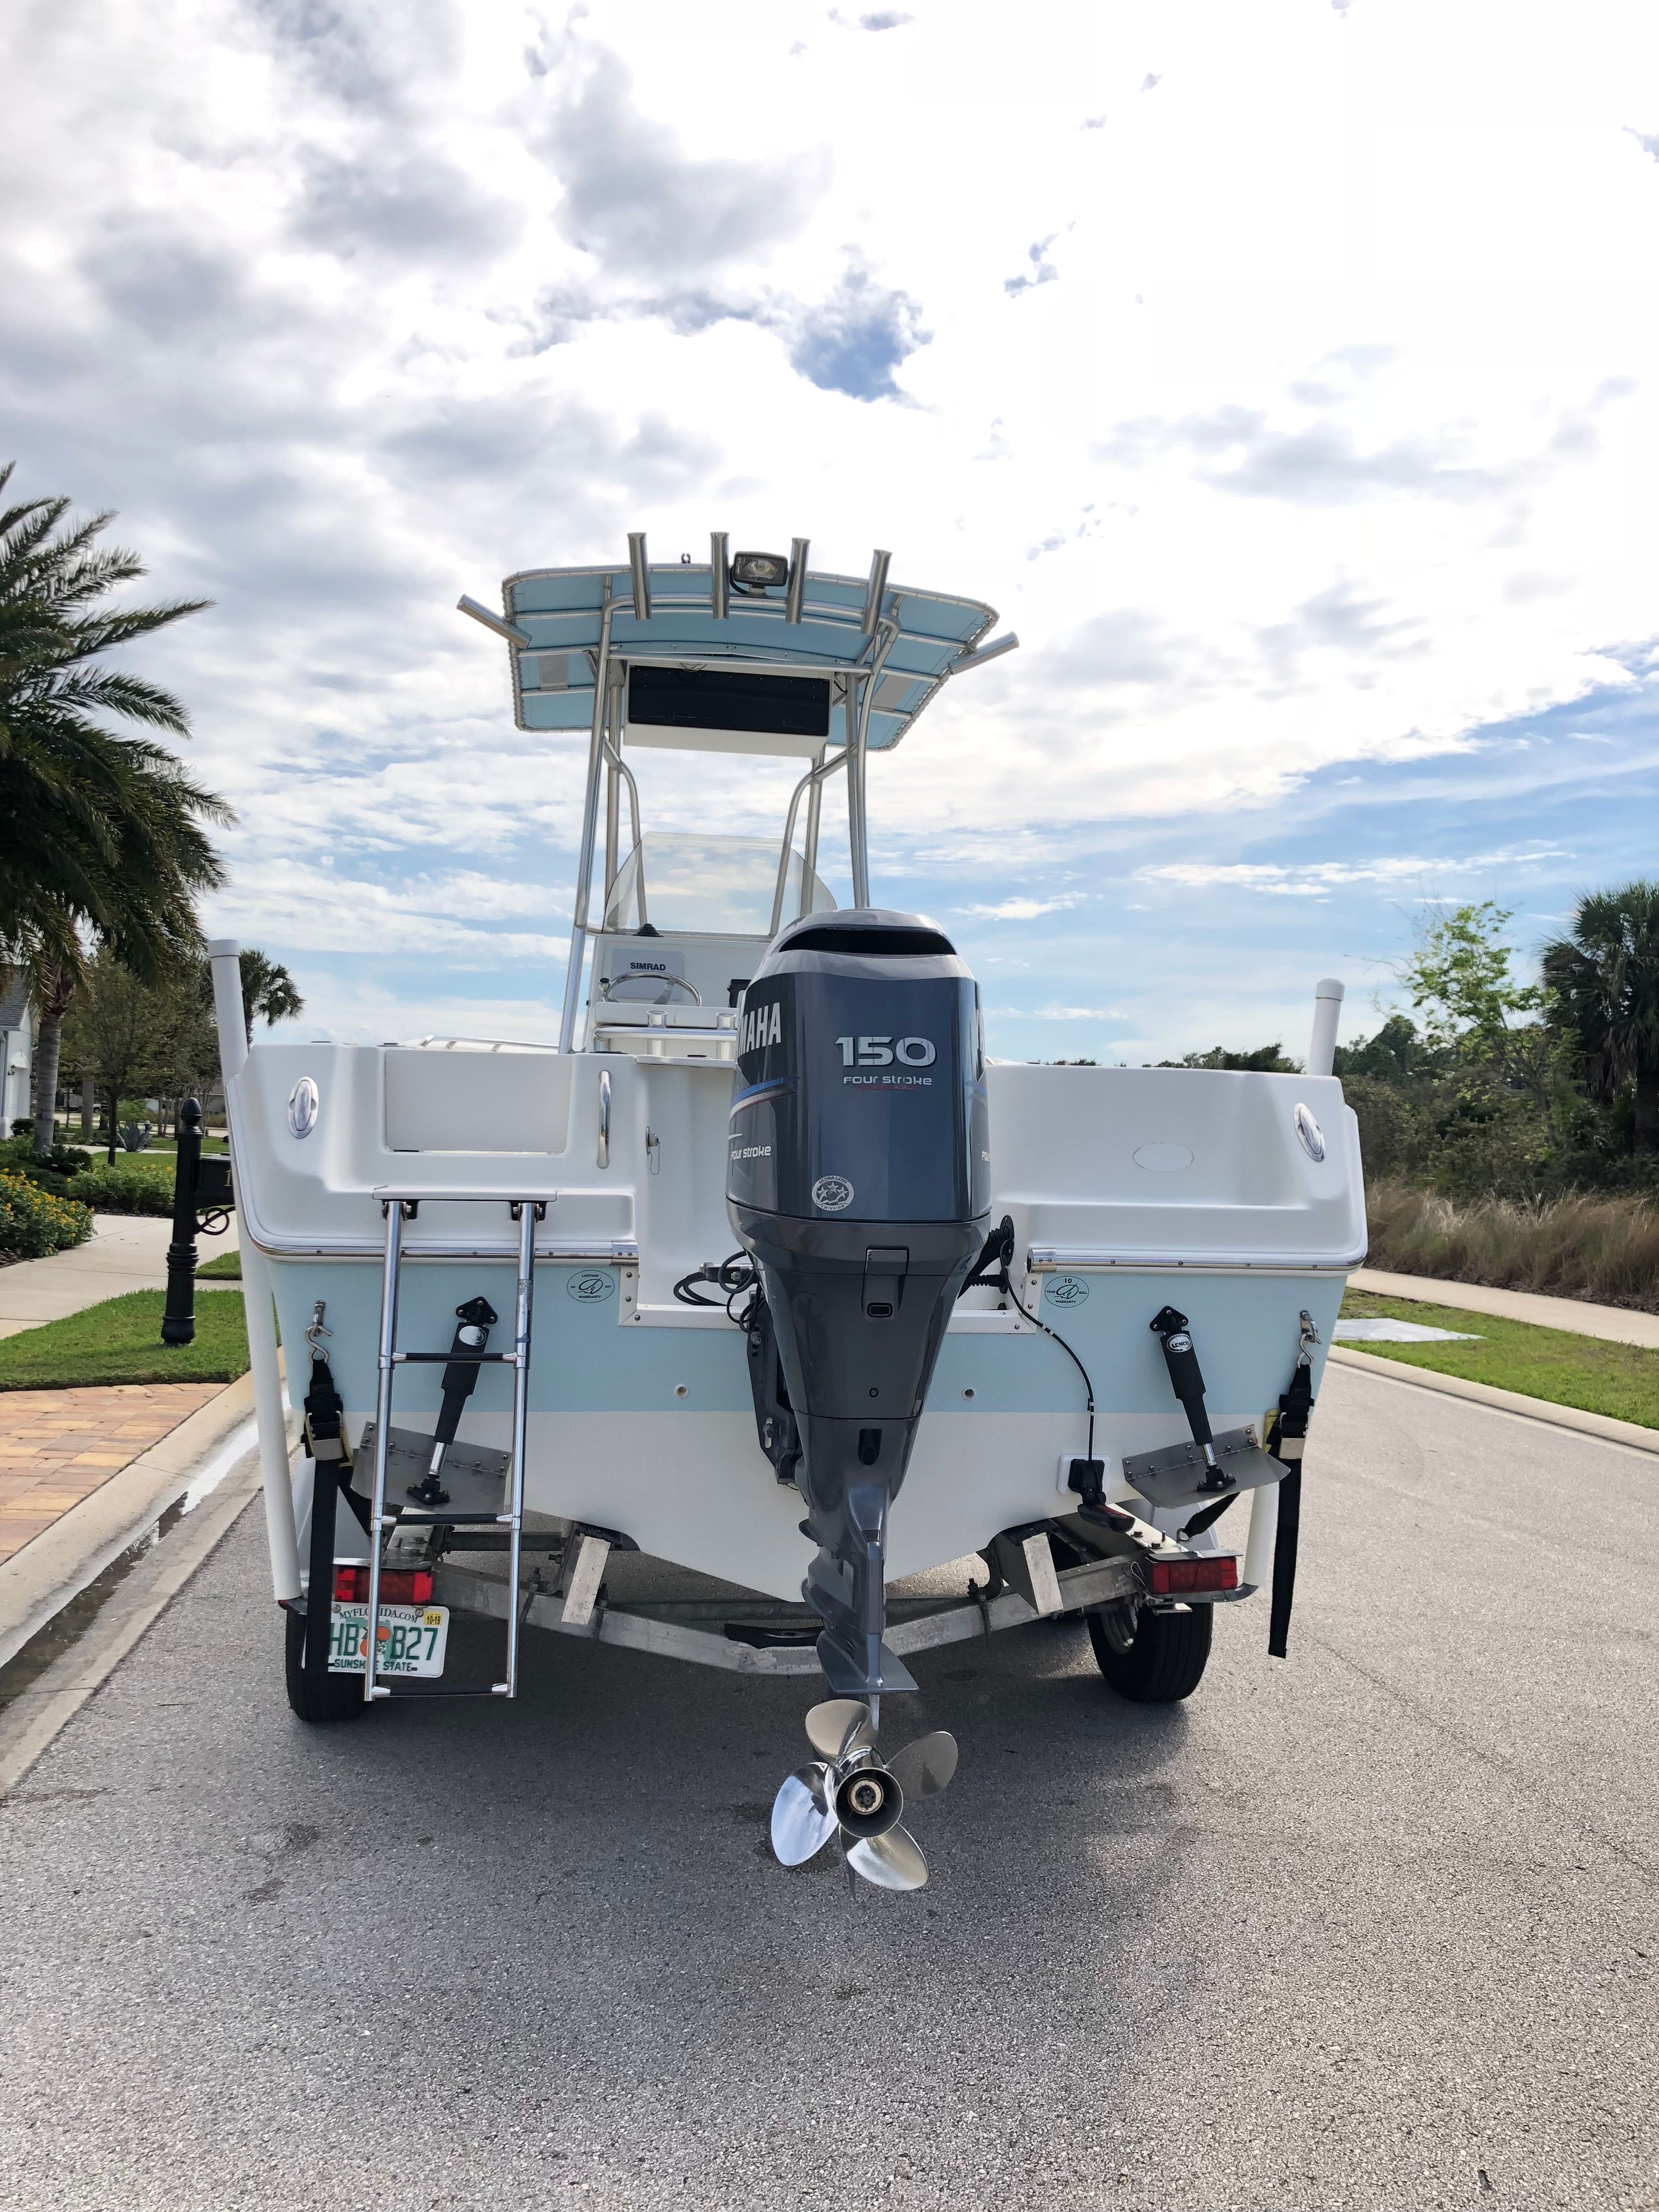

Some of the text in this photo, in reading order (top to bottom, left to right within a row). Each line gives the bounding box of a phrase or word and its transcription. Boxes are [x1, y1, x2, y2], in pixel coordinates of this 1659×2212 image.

[630, 962, 666, 971] SIMRAD
[835, 1036, 936, 1067] 150
[882, 1075, 932, 1086] stroke
[742, 1145, 771, 1159] stroke
[339, 1607, 418, 1623] MYFLIDA.COM
[426, 1614, 442, 1625] 10-19
[329, 1622, 438, 1661] HB B27
[383, 1660, 412, 1672] STATE
